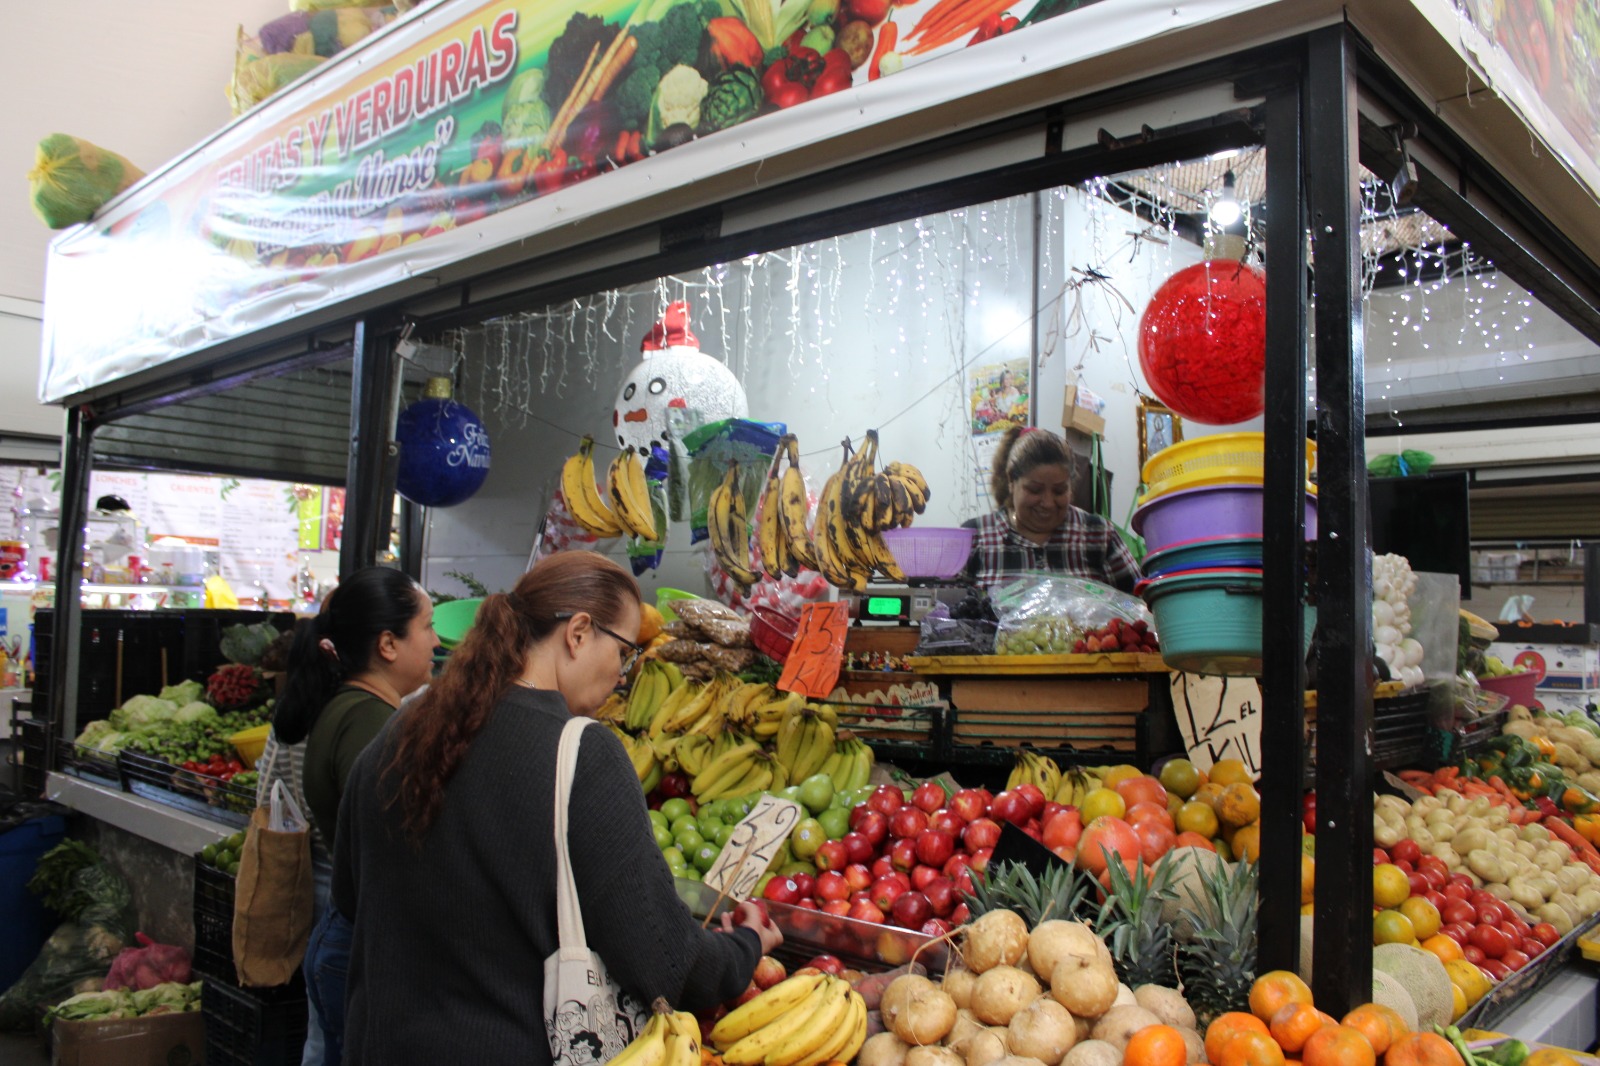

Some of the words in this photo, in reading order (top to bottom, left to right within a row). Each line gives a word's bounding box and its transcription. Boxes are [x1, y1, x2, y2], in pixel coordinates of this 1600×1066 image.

[306, 109, 332, 168] Y
[333, 10, 518, 157] VERDURAS
[1240, 700, 1256, 720] EL
[731, 802, 798, 862] 32
